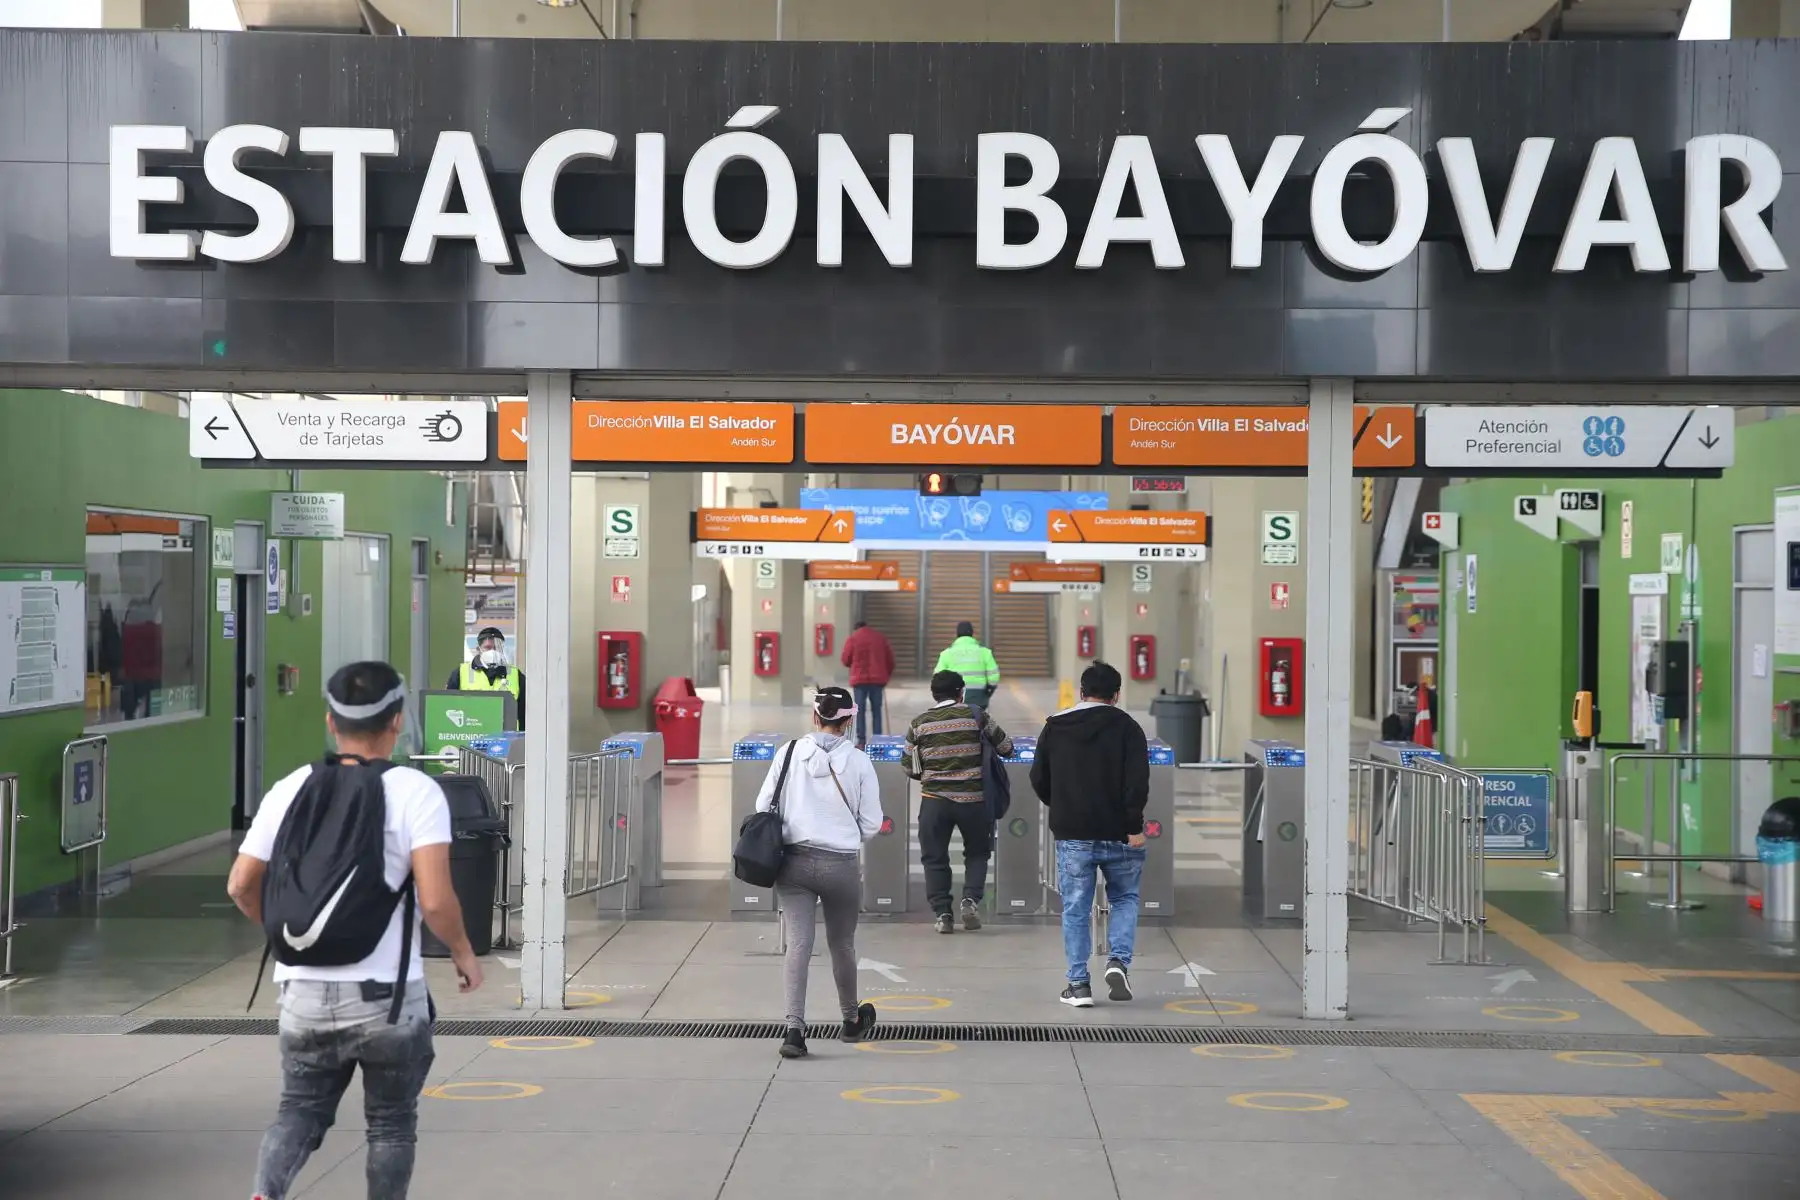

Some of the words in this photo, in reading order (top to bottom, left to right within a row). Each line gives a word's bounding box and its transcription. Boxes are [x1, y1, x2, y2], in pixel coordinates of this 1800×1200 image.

[109, 105, 915, 270] ESTACIÓN
[975, 107, 1790, 273] BAYÓVAR
[278, 412, 322, 427] Venta
[326, 415, 336, 430] y
[341, 412, 406, 430] Recarga
[588, 414, 653, 429] Dirección
[653, 415, 685, 429] Villa
[690, 415, 704, 429] El
[708, 415, 777, 430] Salvador
[1130, 417, 1195, 432] Dirección
[1197, 418, 1230, 432] Villa
[1234, 418, 1249, 432] El
[1478, 419, 1549, 434] Atención
[891, 416, 1016, 445] BAYÓVAR
[299, 432, 319, 447] de
[324, 431, 384, 449] Tarjetas
[731, 437, 759, 446] Andén
[761, 437, 777, 447] Sur
[1130, 439, 1159, 449] Andén
[1160, 439, 1176, 449] Sur
[1466, 439, 1562, 454] Preferencial
[292, 495, 325, 505] CUIDA
[611, 509, 633, 534] S
[1269, 516, 1292, 541] S
[760, 561, 773, 576] S
[1135, 565, 1149, 581] S
